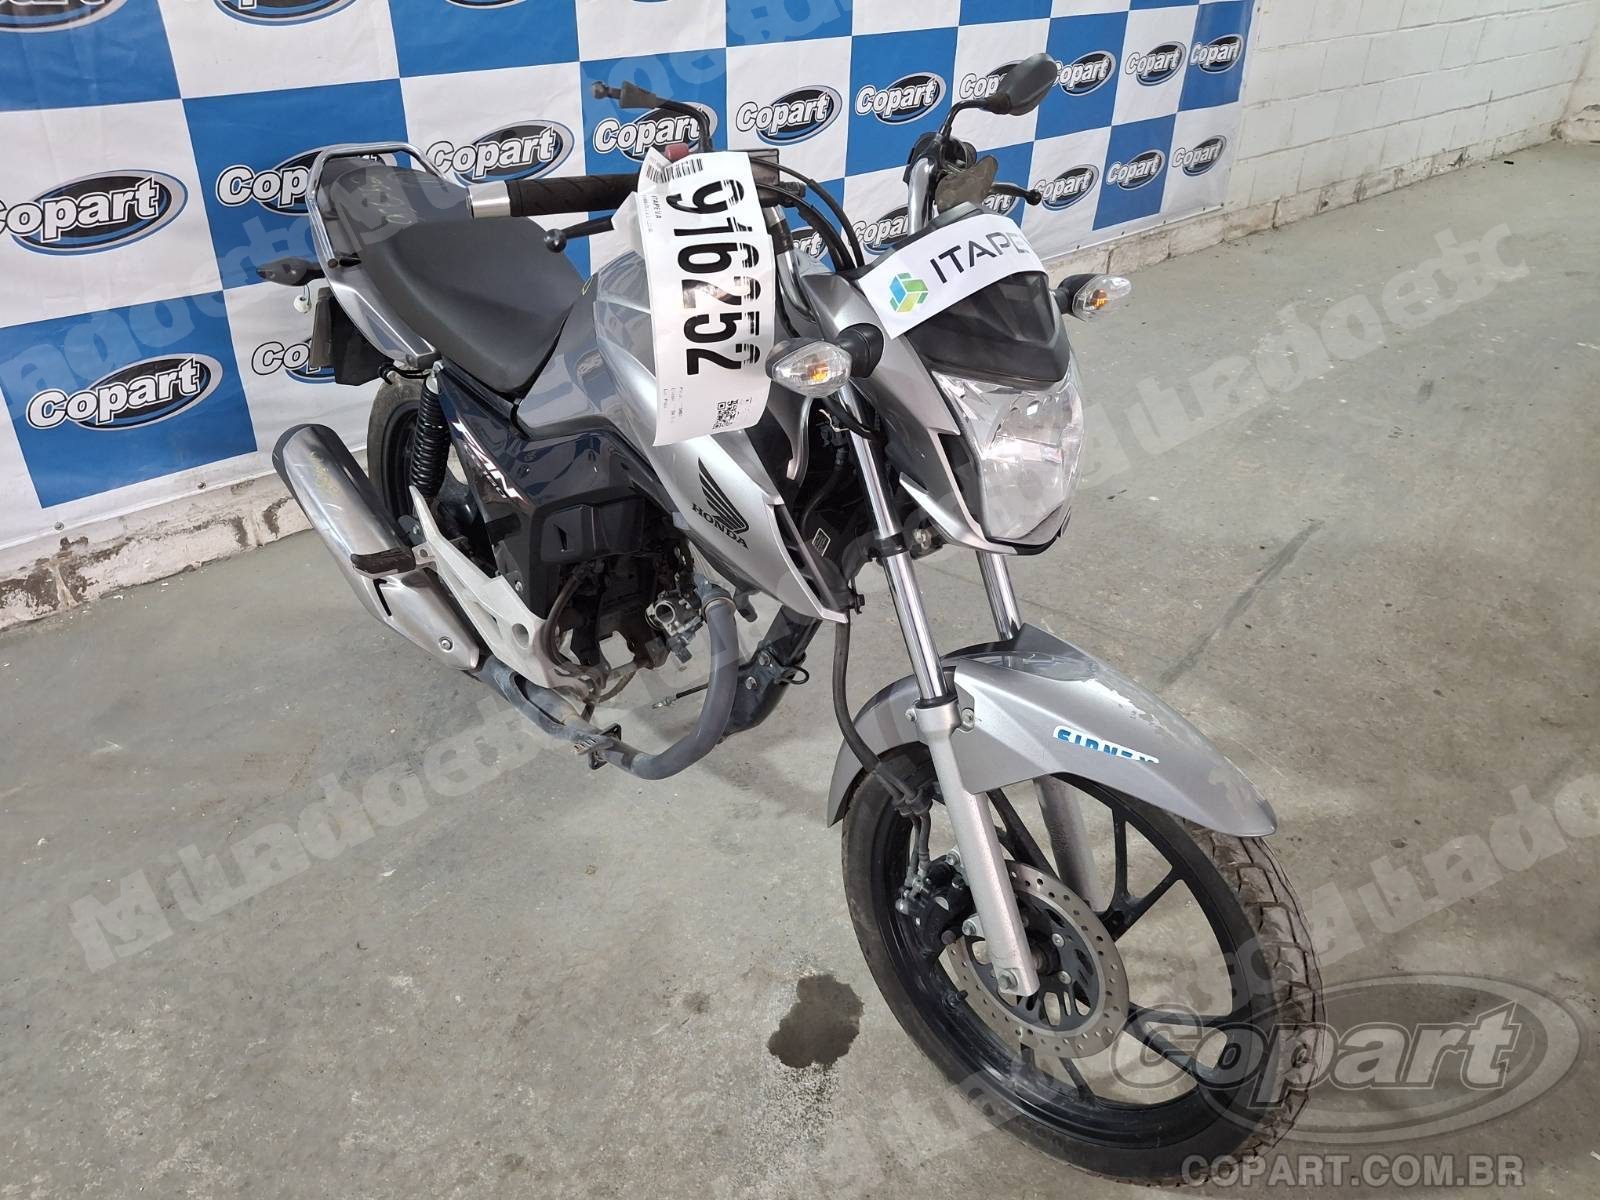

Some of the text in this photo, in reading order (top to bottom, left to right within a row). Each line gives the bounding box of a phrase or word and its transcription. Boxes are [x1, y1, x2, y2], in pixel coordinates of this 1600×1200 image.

[1052, 57, 1110, 90] opart
[1125, 50, 1179, 77] Copart
[1189, 41, 1241, 66] Copart
[735, 92, 831, 136] Copart
[856, 76, 938, 117] Copart
[427, 126, 557, 180] Copart
[1106, 155, 1162, 185] Copart
[1172, 142, 1224, 168] Copart
[0, 176, 160, 243] opart
[666, 178, 762, 376] 916252
[27, 356, 202, 430] Copart
[692, 503, 751, 553] HONDA
